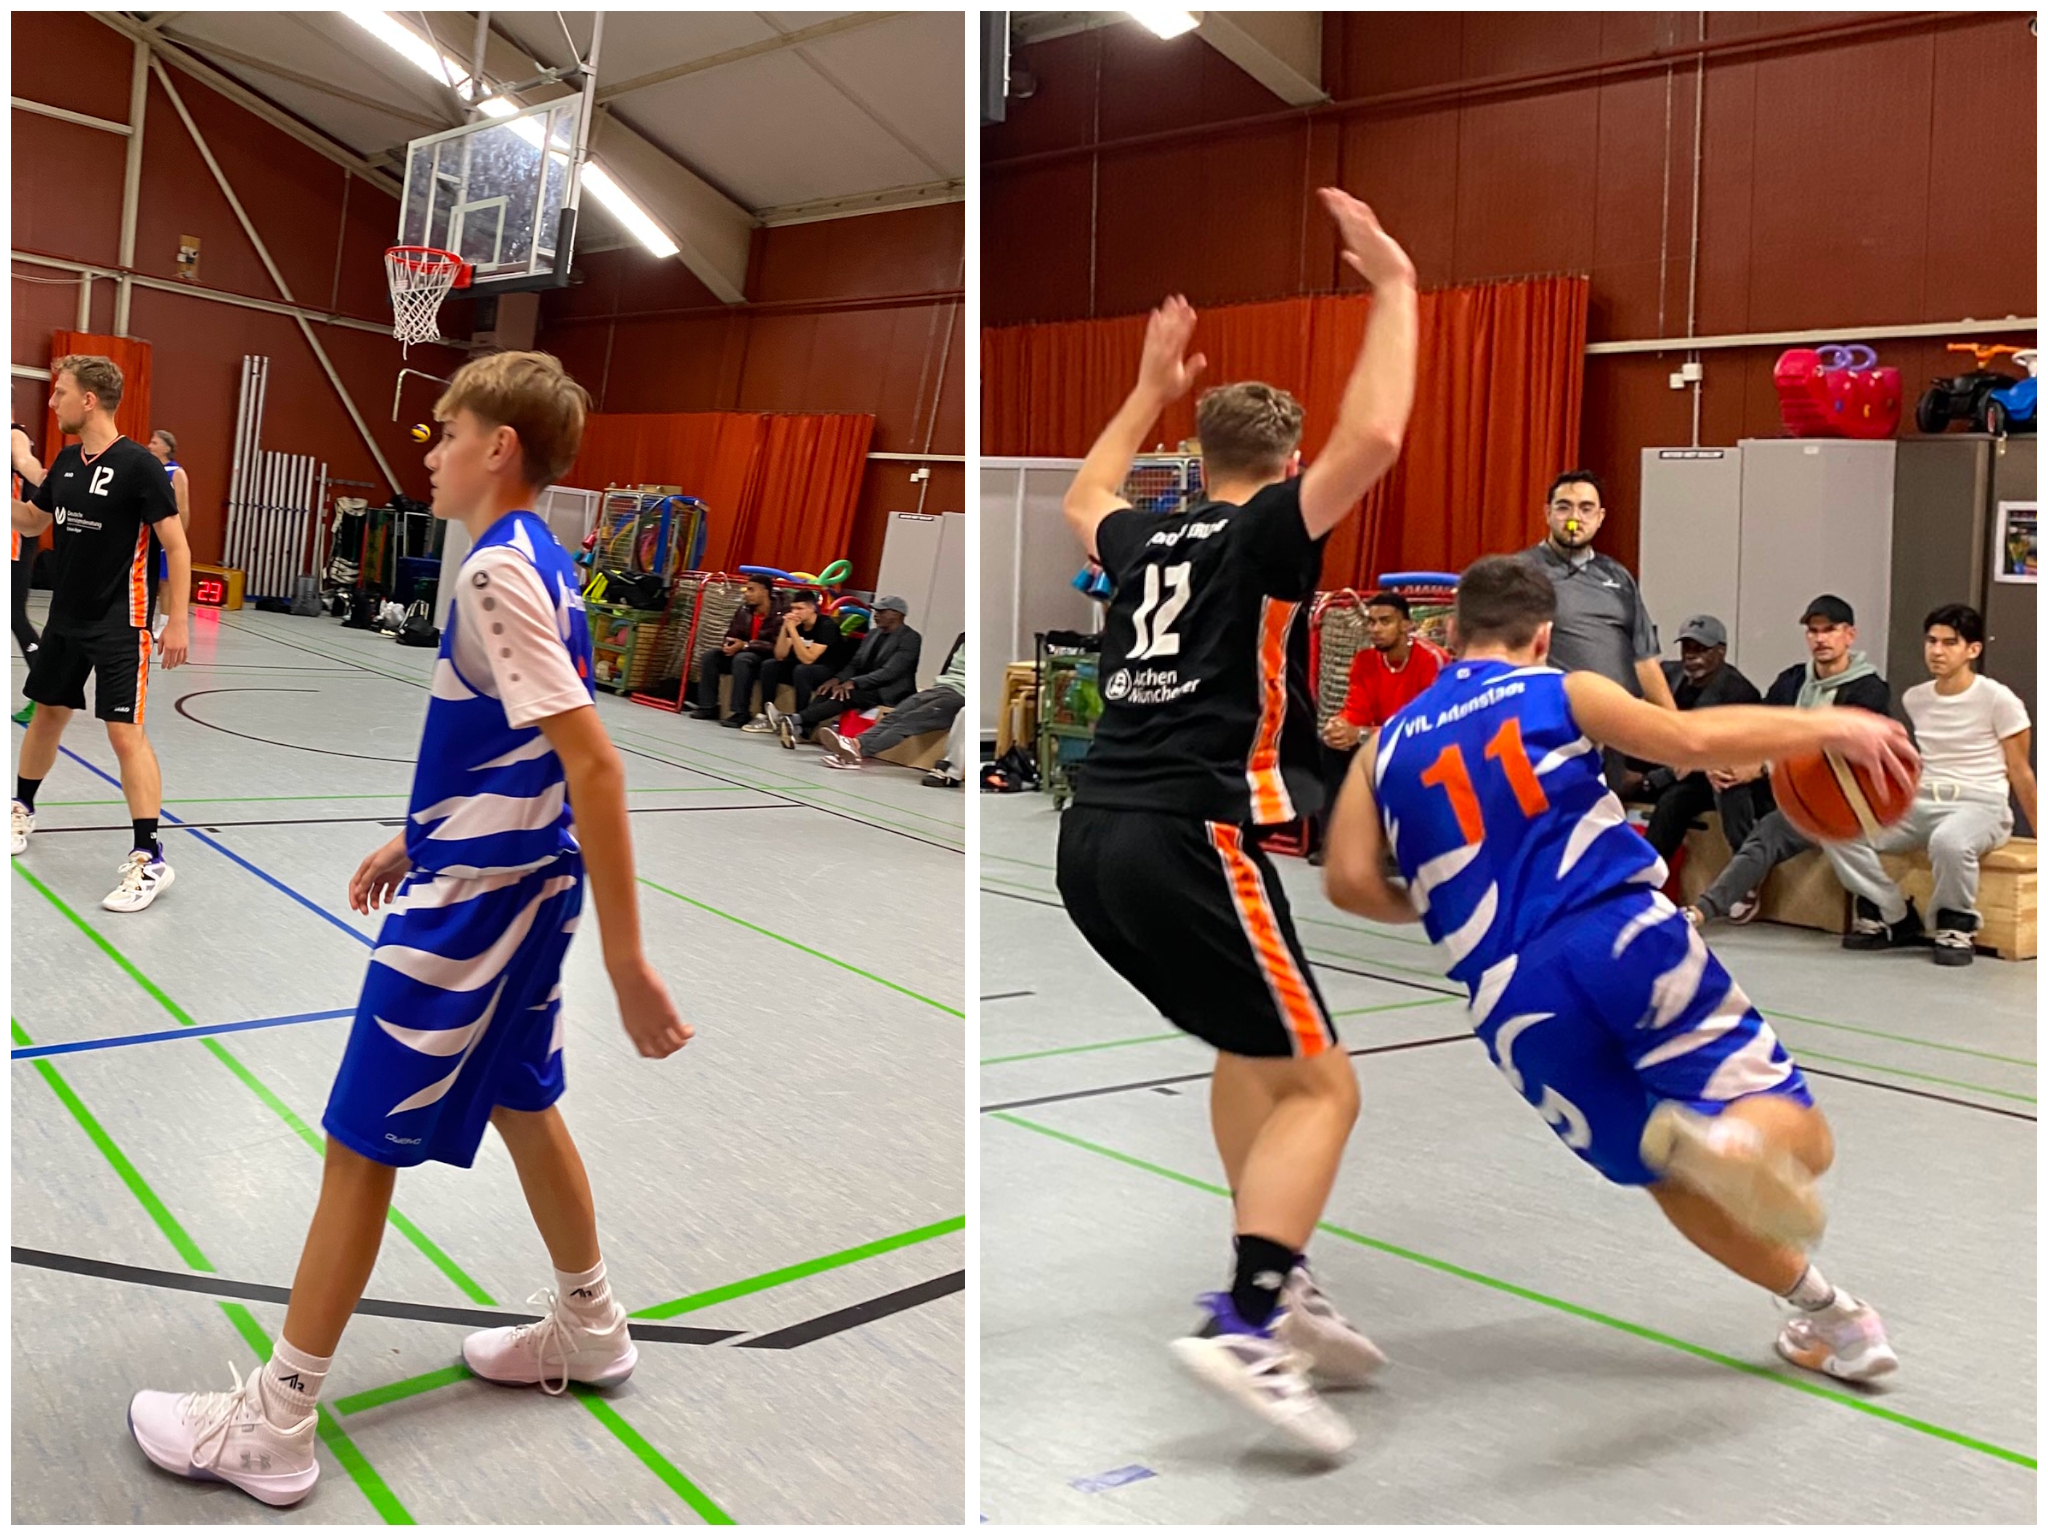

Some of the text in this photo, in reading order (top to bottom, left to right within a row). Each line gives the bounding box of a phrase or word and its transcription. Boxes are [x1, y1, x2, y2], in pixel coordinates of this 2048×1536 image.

[88, 465, 115, 497] 12
[197, 581, 222, 603] 23
[1125, 560, 1192, 661] 12
[1419, 716, 1550, 847] 11
